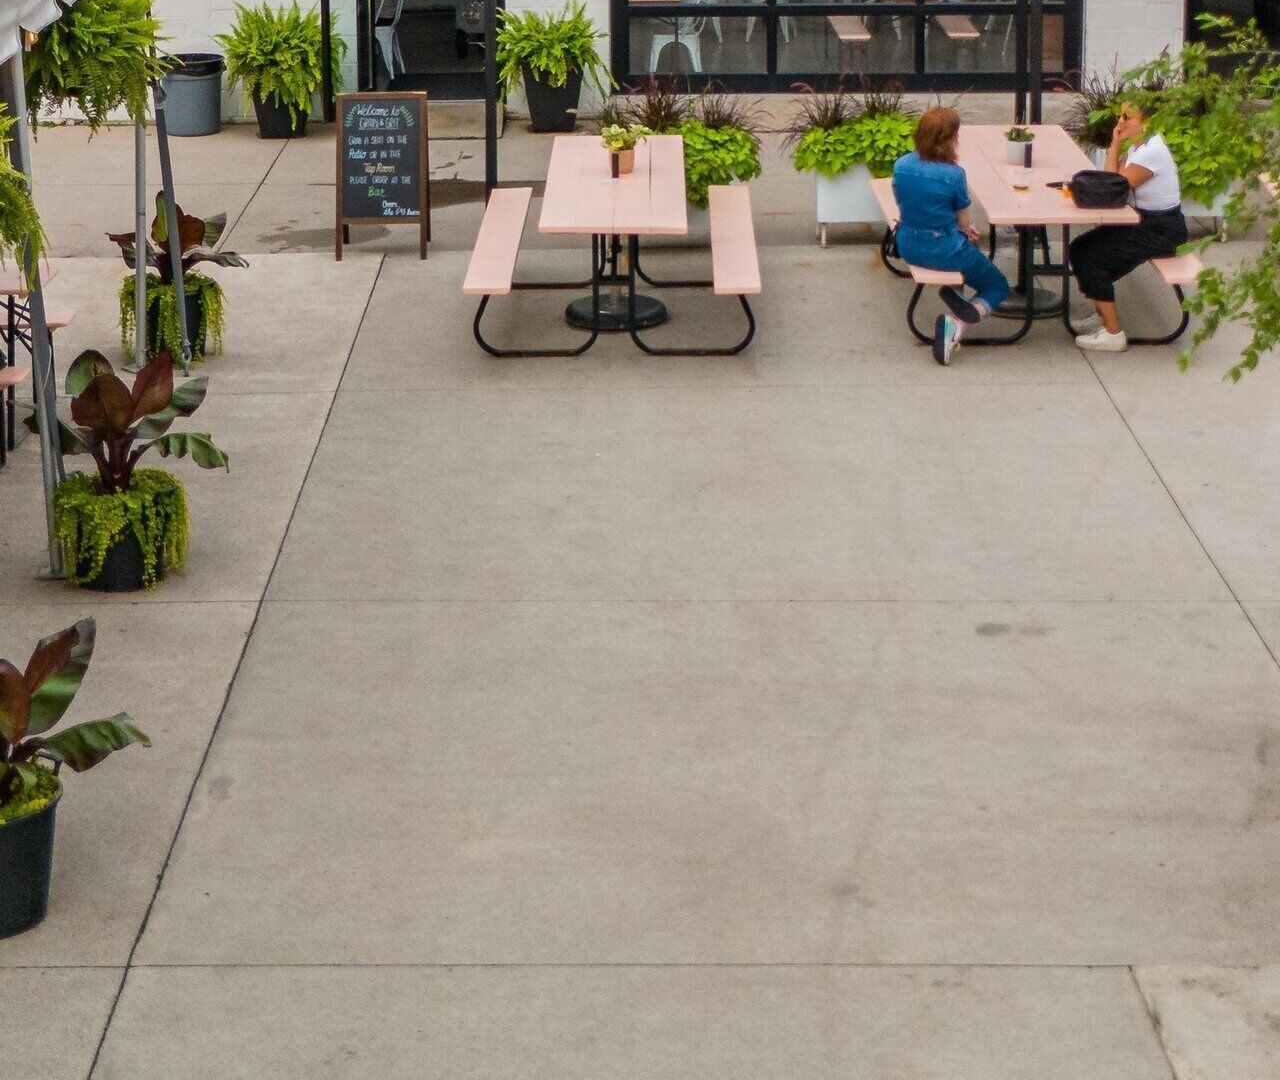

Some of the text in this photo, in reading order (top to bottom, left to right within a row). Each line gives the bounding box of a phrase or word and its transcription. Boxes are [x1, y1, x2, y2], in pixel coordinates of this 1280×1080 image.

[356, 104, 400, 117] Welcome to
[349, 176, 368, 184] PLEASE
